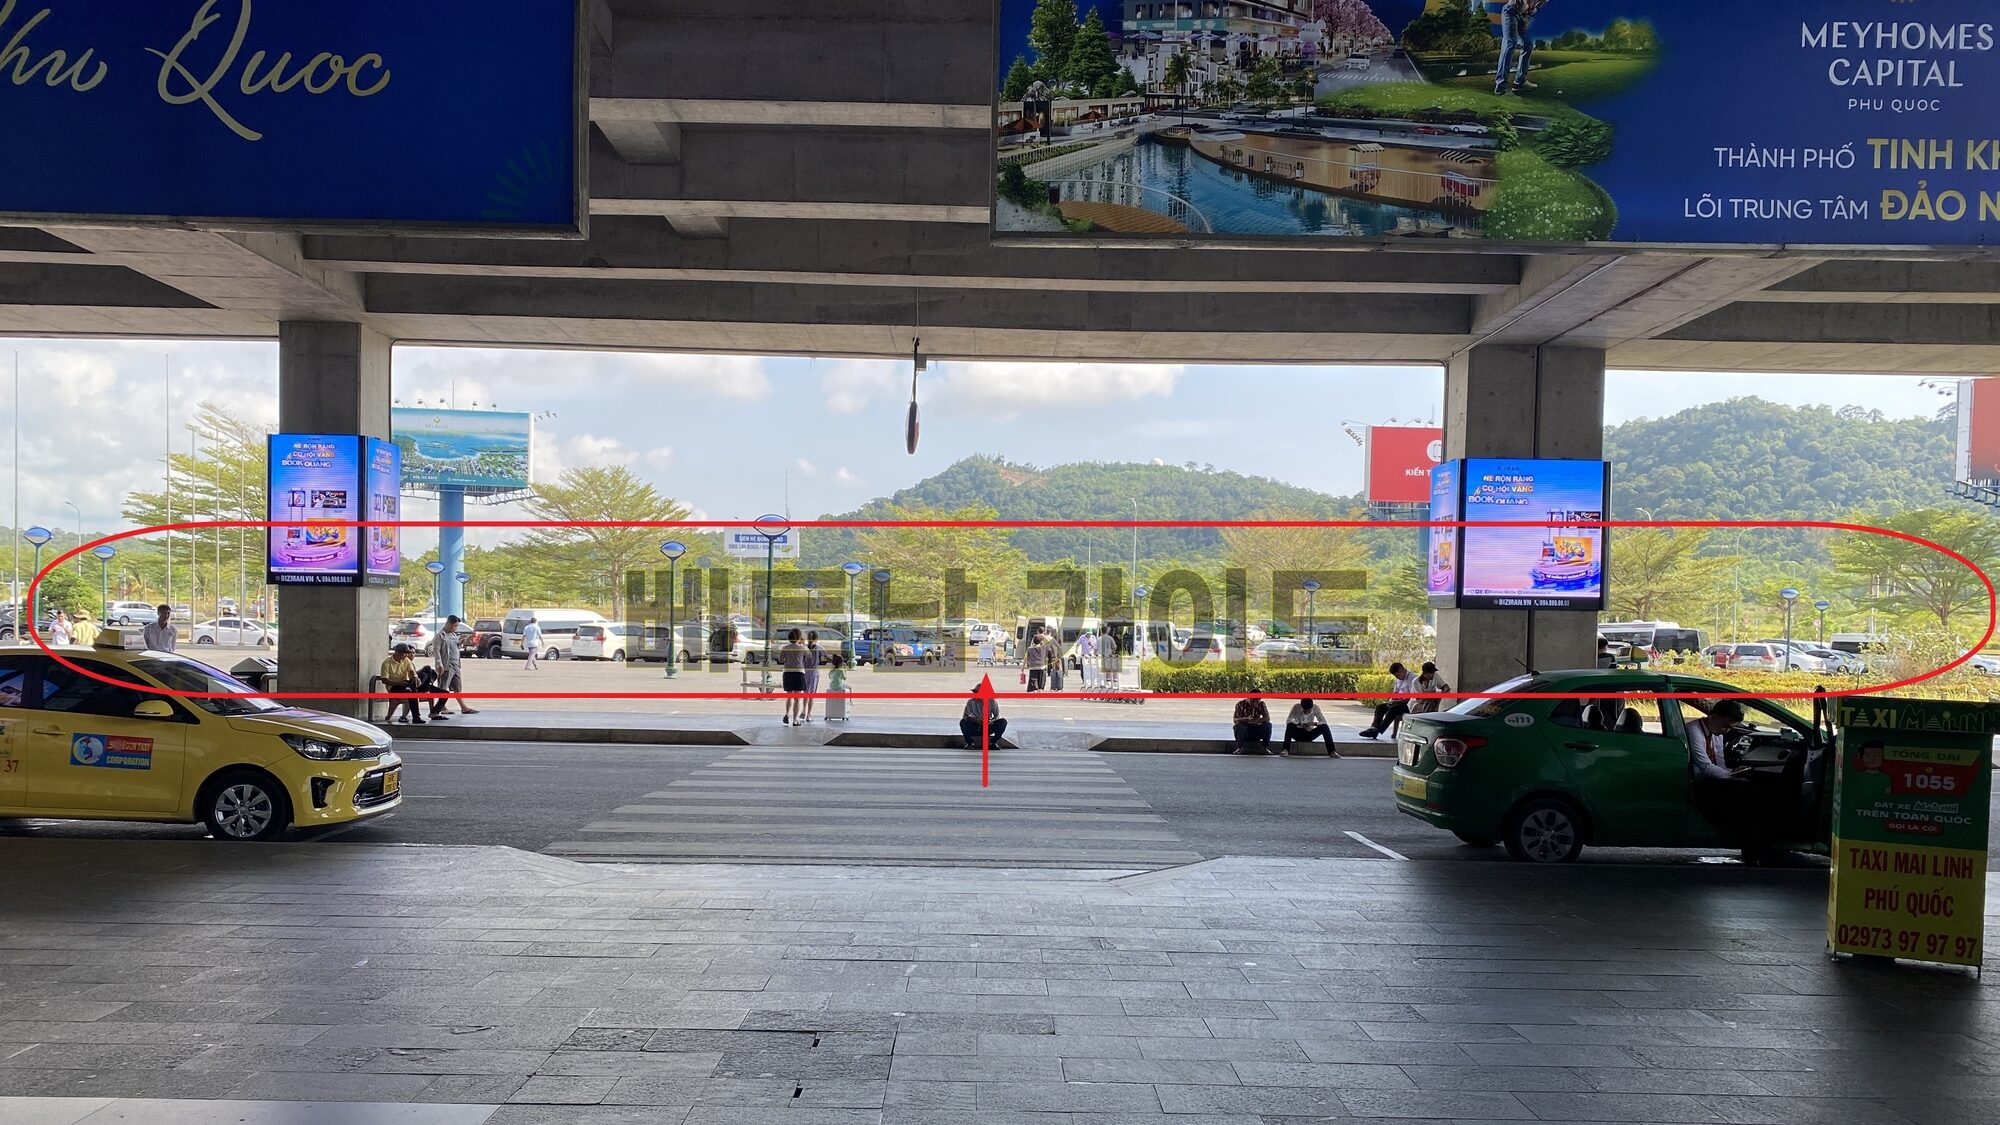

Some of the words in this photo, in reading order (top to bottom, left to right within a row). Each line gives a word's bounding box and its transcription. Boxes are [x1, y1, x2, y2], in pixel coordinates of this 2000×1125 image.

[1801, 21, 1994, 51] MEYHOMES
[144, 0, 391, 141] Quoc
[1828, 58, 1964, 87] CAPITAL
[1848, 98, 1883, 111] PHU
[1891, 98, 1940, 113] QUOC
[1714, 142, 1795, 168] THÀNH
[1803, 142, 1856, 168] PHỐ
[1867, 138, 1953, 169] TINH
[1685, 193, 1722, 219] LÕI
[1729, 198, 1813, 220] TRUNG
[1819, 195, 1868, 220] TÂM
[1880, 180, 1967, 221] ĐẢO
[1405, 467, 1424, 476] KIẾN
[1841, 707, 1897, 729] TAXI
[106, 756, 150, 766] CORPORATION
[1904, 773, 1956, 791] 1055
[1849, 848, 1889, 872] TAXI
[1894, 852, 1927, 875] MAI
[1932, 855, 1974, 880] LINH
[1864, 885, 1899, 912] PHÚ
[1906, 886, 1954, 918] QUỐC
[1838, 924, 1893, 950] 02973
[1899, 930, 1921, 953] 97
[1926, 933, 1949, 956] 97
[1955, 936, 1978, 959] 97
